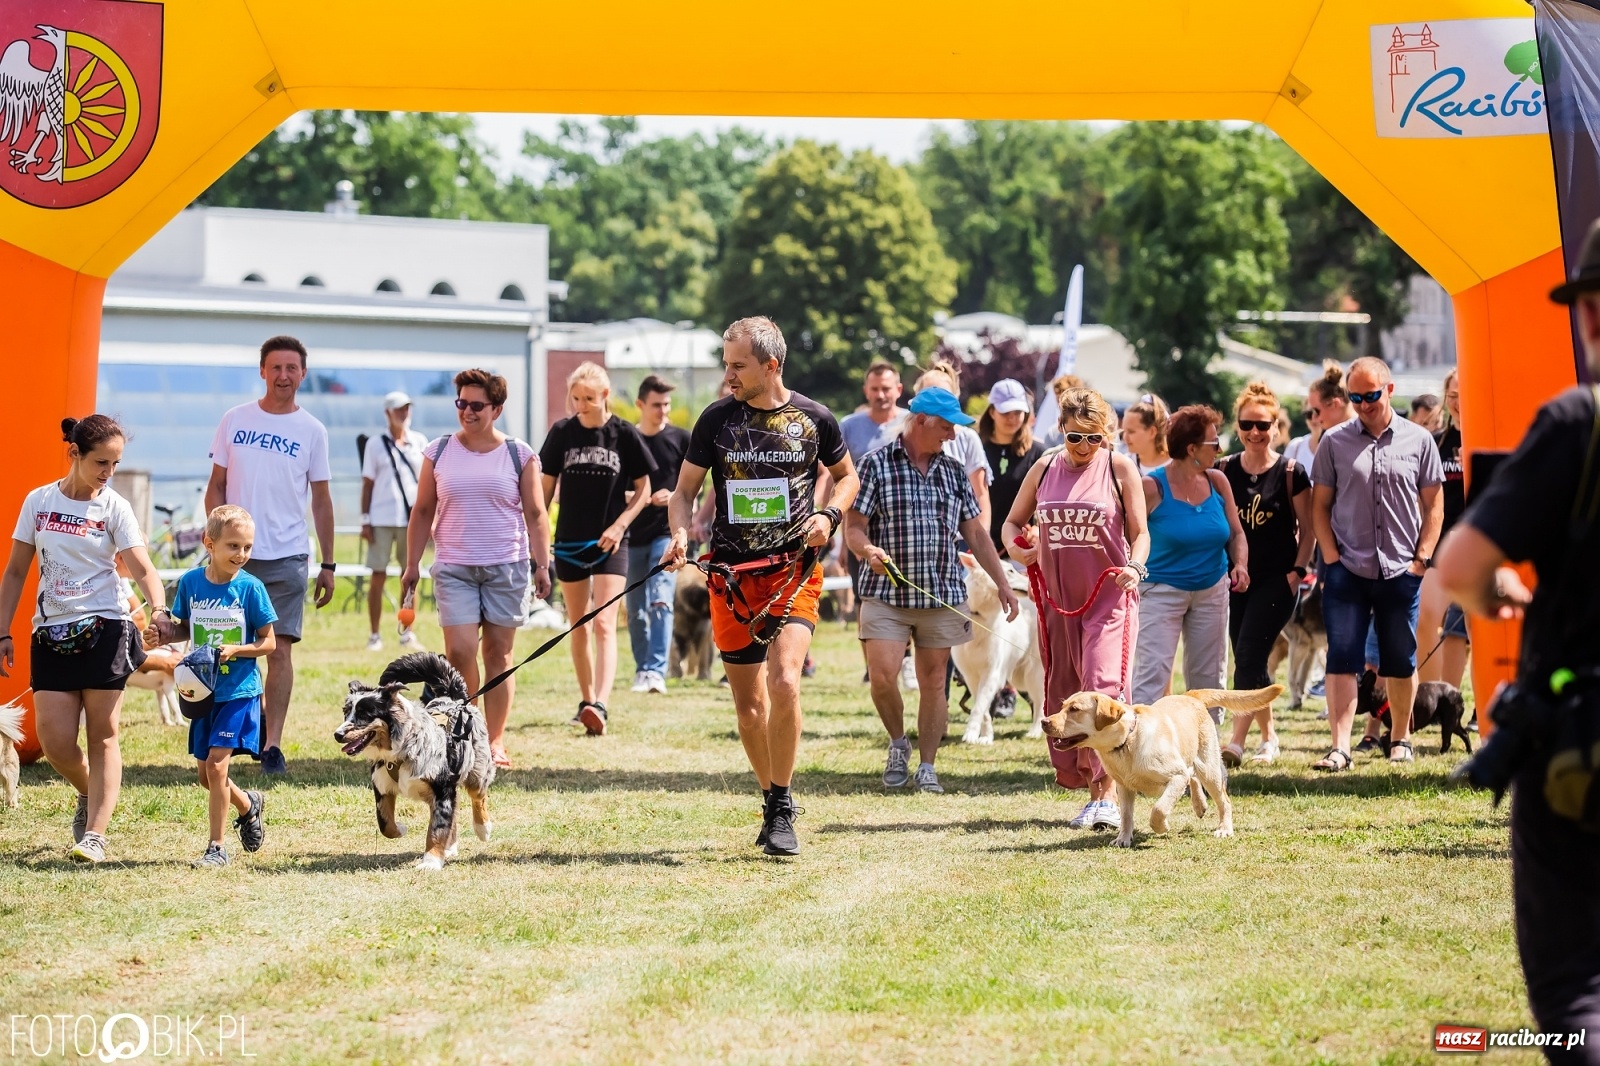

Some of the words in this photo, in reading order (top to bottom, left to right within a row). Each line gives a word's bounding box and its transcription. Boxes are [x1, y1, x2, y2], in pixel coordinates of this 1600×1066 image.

[1400, 67, 1546, 135] Racibó
[726, 451, 806, 463] RUNMAGEDDON
[750, 502, 767, 515] 18
[1037, 508, 1107, 527] HIPPIE
[47, 522, 87, 536] GRANIC
[1049, 525, 1099, 542] SOUL
[207, 633, 224, 646] 12
